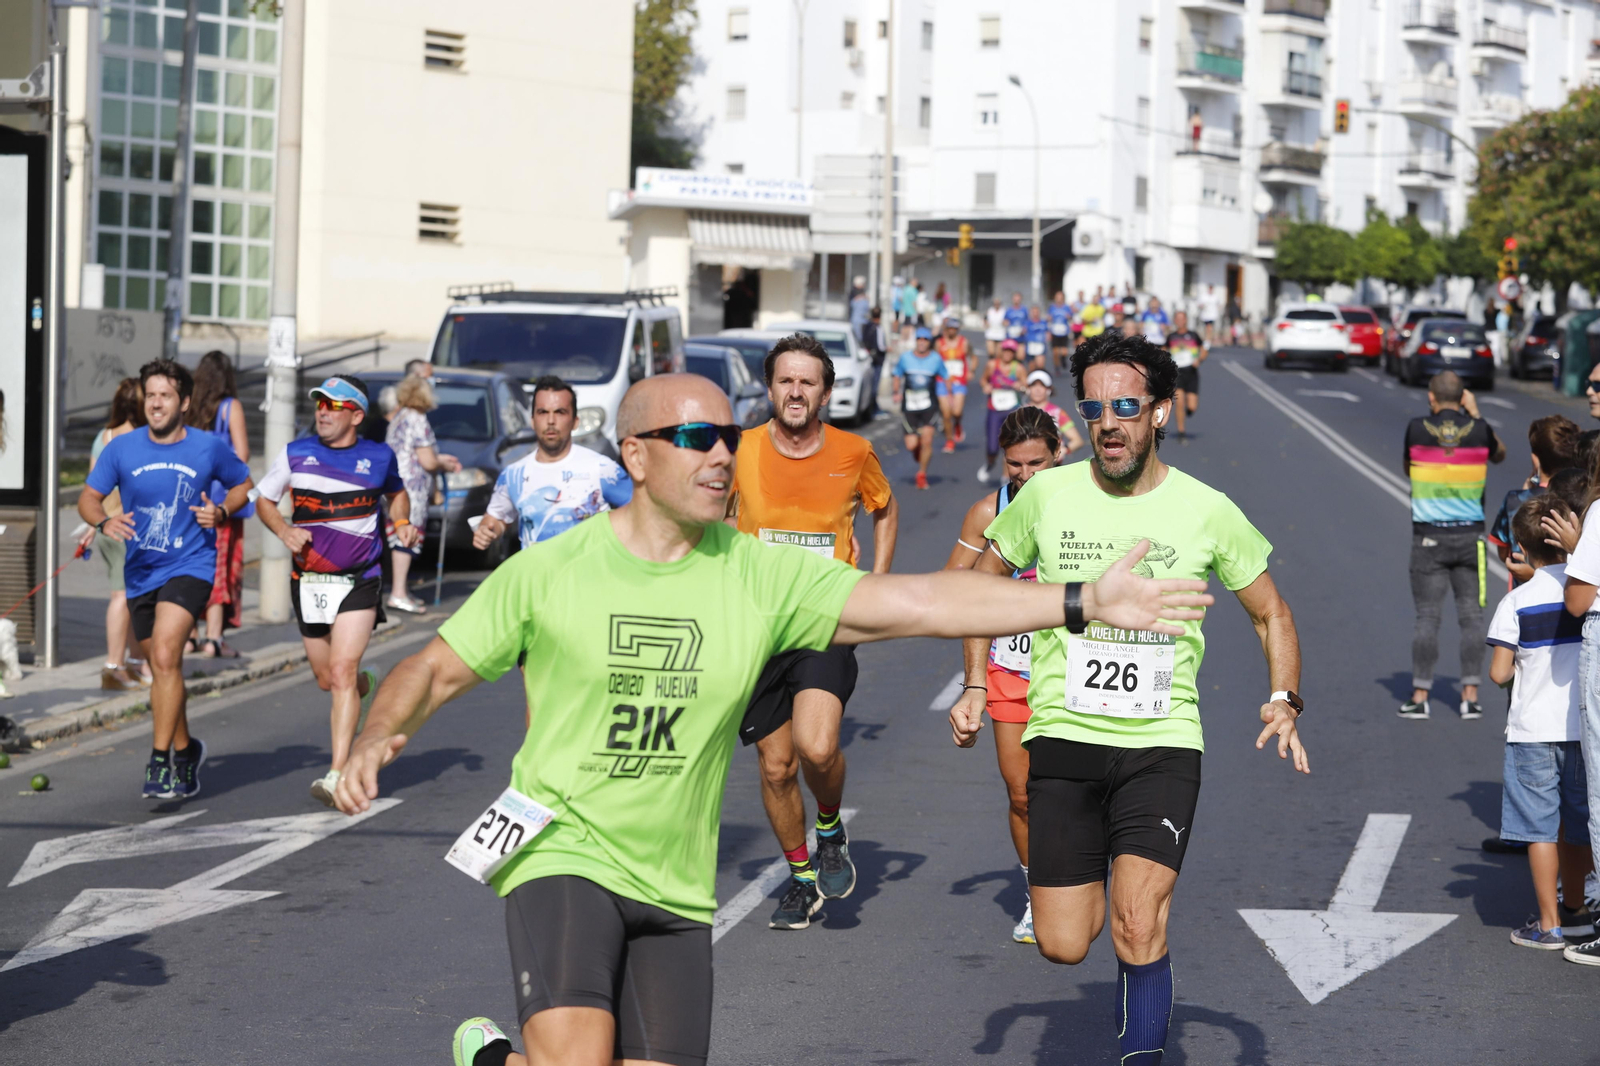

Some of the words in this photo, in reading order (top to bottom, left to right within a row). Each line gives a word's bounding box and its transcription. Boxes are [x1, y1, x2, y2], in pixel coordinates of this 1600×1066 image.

[679, 186, 748, 198] PATATAS
[754, 190, 807, 202] FRITAS
[764, 532, 773, 541] 34
[774, 533, 799, 544] VUELTA
[800, 536, 806, 545] A
[806, 536, 830, 546] HUELVA
[1060, 530, 1075, 539] 33
[1060, 541, 1103, 550] VUELTA
[1105, 542, 1115, 550] A
[1058, 552, 1103, 560] HUELVA
[1058, 563, 1080, 571] 2019
[1090, 626, 1126, 642] VUELTA
[1128, 630, 1136, 642] A
[1137, 630, 1170, 643] HUELVA
[1081, 641, 1111, 652] MIGUEL
[1088, 649, 1112, 658] LOZANO
[1084, 659, 1139, 692] 226
[655, 675, 698, 698] HUELVA
[1098, 692, 1135, 700] INDEPENDIENTE
[606, 704, 686, 751] 21K
[473, 807, 525, 856] 270
